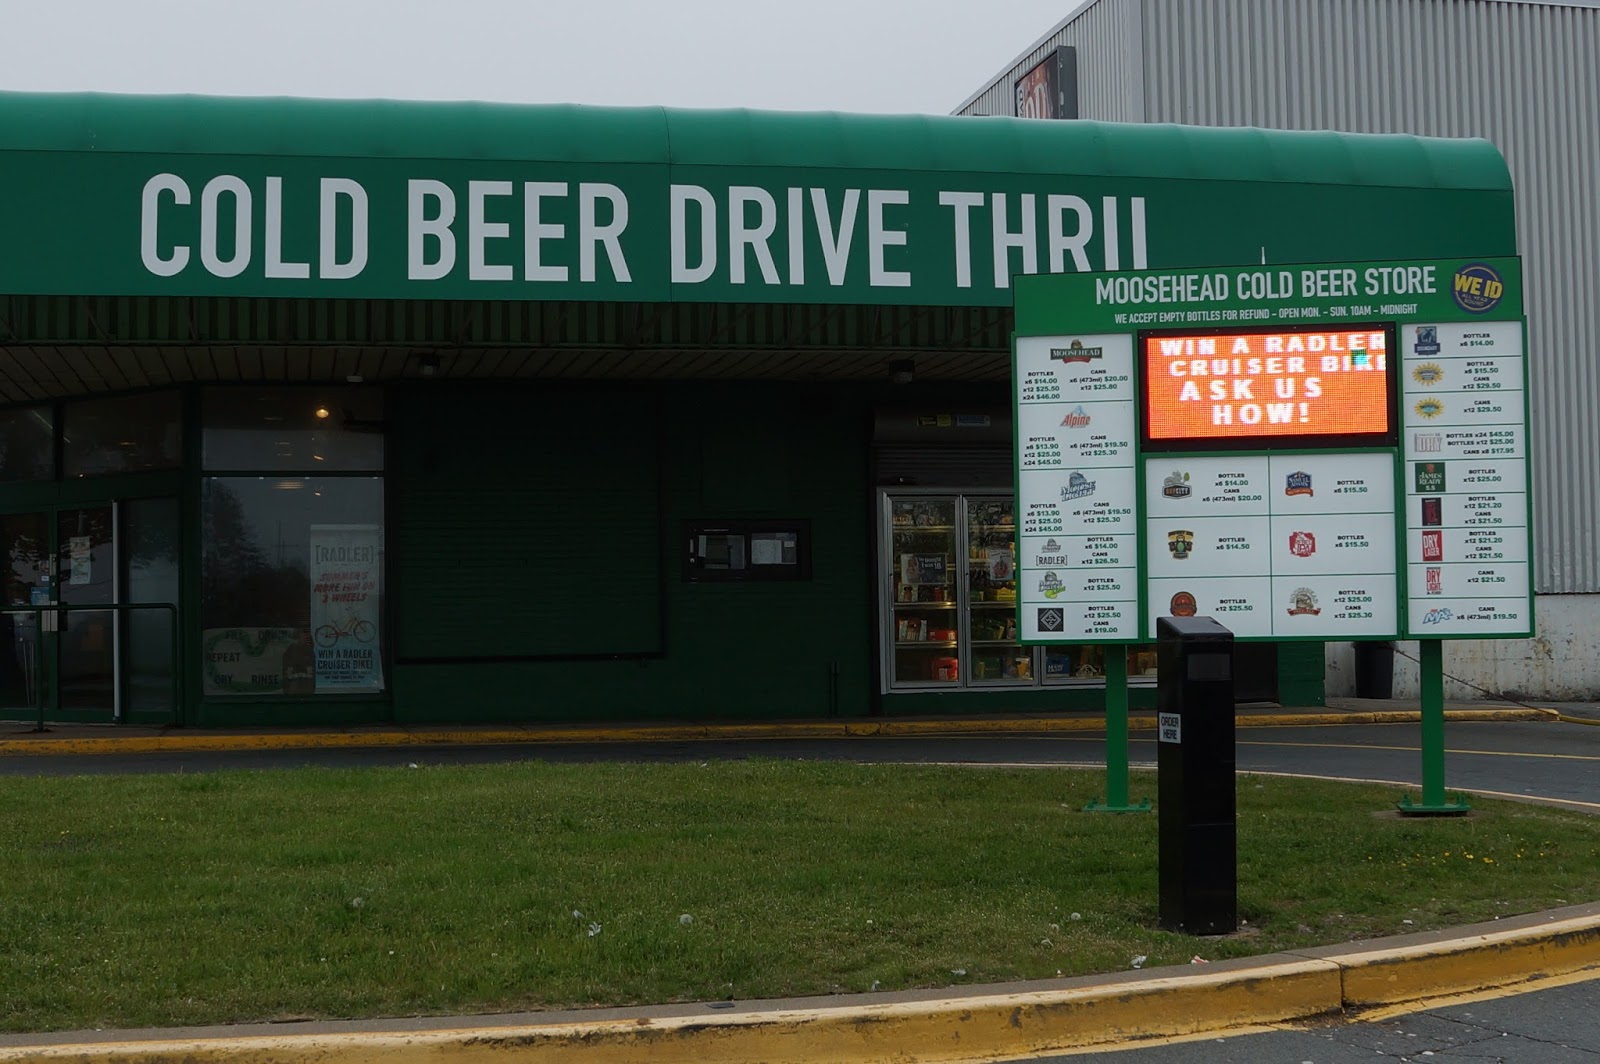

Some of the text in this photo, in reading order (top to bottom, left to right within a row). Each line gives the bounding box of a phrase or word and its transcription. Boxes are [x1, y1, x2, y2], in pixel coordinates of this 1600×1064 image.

[141, 172, 368, 278] COLD
[408, 179, 633, 282] BEER
[670, 184, 911, 287] DRIVE
[1096, 266, 1436, 304] MOOSEHEAD COLD BEER STORE
[1455, 273, 1502, 298] WE ID
[1115, 304, 1418, 323] WE ACCEPT EMPTY BOTTLES FOR REFUND OPEN MON. SUN. 10AM MIDNIGHT
[1159, 333, 1385, 356] WIN A RADLER
[1052, 349, 1100, 357] MOOSEHEAD
[1169, 356, 1305, 377] CRUISER
[1180, 377, 1323, 401] ASK US
[1061, 413, 1091, 428] Alpine
[1212, 402, 1310, 425] HOW!
[1423, 534, 1438, 548] DRY
[1427, 570, 1440, 583] DRY
[318, 649, 372, 658] WIN A RADLER
[318, 660, 350, 669] CRUISER
[252, 675, 279, 684] RINSE
[1161, 716, 1179, 728] ORDER
[1163, 729, 1177, 739] HERE
